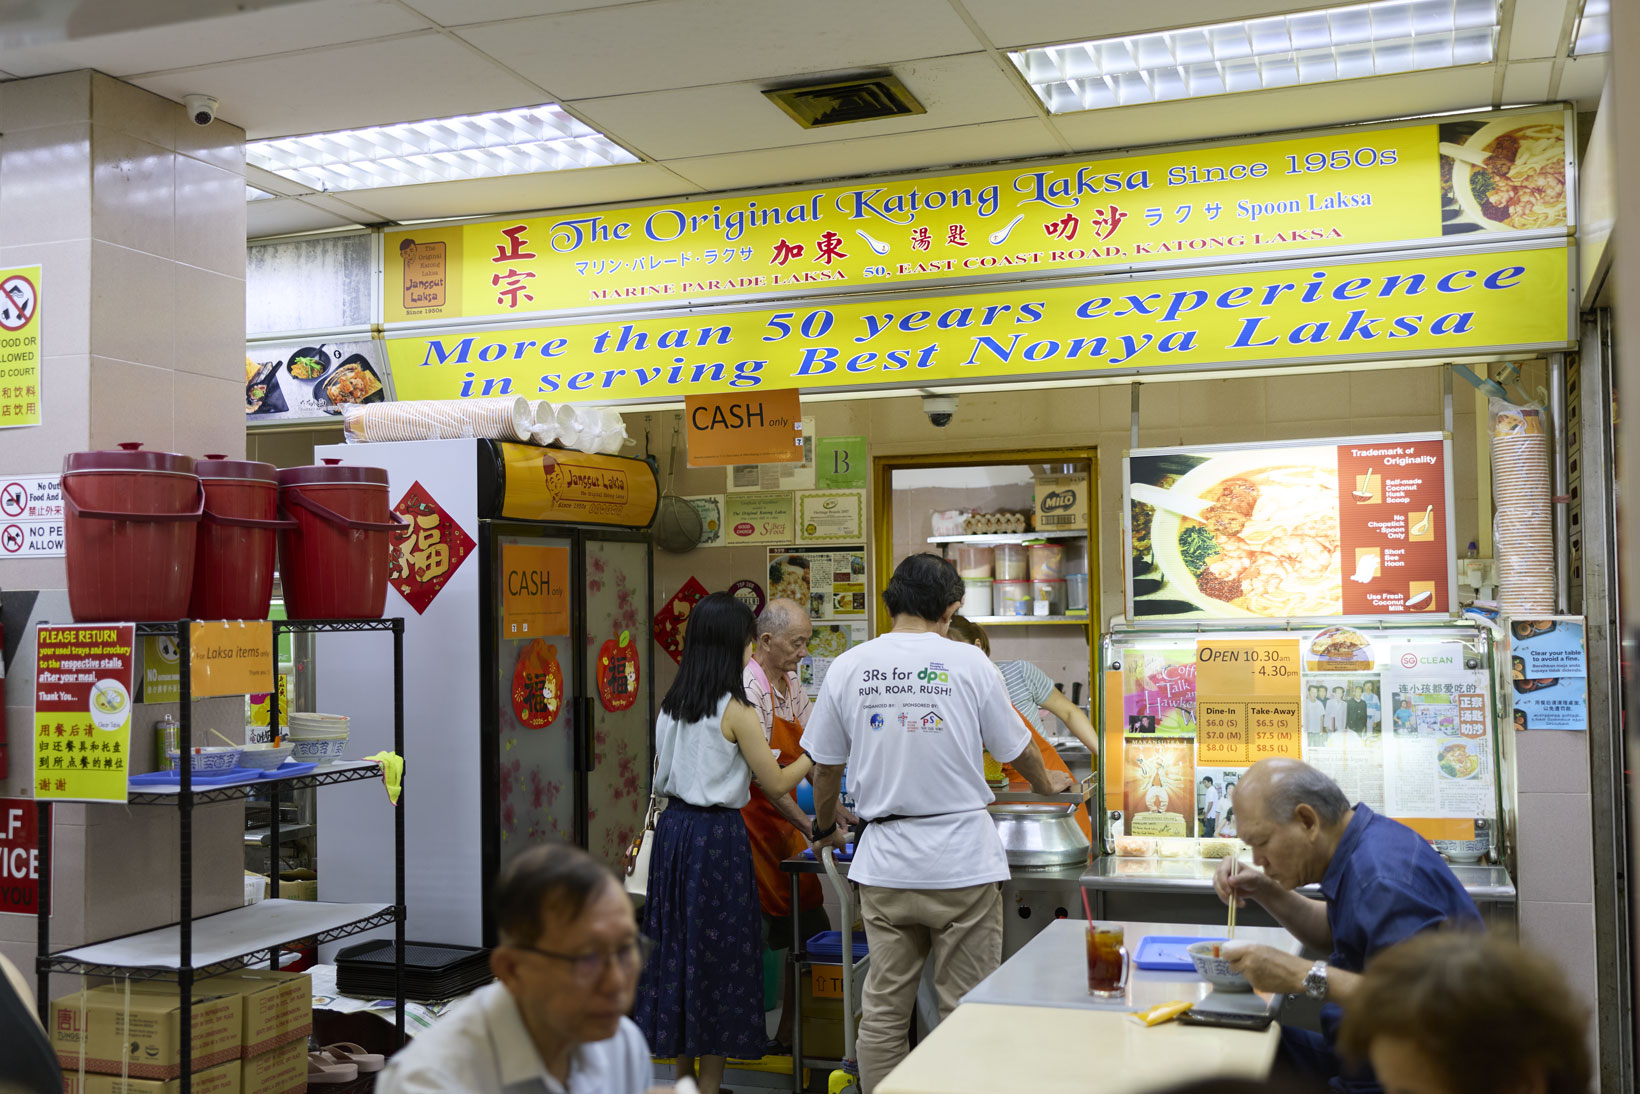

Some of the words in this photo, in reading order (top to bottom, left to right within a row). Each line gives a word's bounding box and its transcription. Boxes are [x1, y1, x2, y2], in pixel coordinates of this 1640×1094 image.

[550, 217, 632, 253] The
[645, 194, 826, 242] Original
[835, 184, 999, 225] Katong
[1013, 166, 1153, 208] Laksa
[1167, 161, 1268, 187] Since
[1285, 146, 1398, 176] 1950s
[1236, 200, 1300, 221] Spoon
[1308, 192, 1373, 212] Laksa
[863, 265, 892, 280] 50,
[897, 259, 957, 275] EAST
[963, 252, 1044, 269] COAST
[1050, 245, 1128, 262] ROAD,
[1133, 235, 1246, 256] KATONG
[1253, 227, 1345, 246] LAKSA
[491, 224, 537, 309] 正宗
[406, 278, 443, 291] Janggut
[590, 283, 675, 301] MARINE
[681, 276, 767, 293] PARADE
[772, 269, 848, 286] LAKSA
[411, 292, 438, 303] Laksa
[418, 336, 568, 367] More
[593, 324, 734, 355] than
[762, 309, 835, 342] 50
[854, 301, 1046, 343] years
[1075, 265, 1526, 324] experience
[24, 337, 36, 346] OR
[459, 372, 514, 398] in
[538, 356, 768, 388] serving
[790, 342, 940, 377] Best
[960, 329, 1199, 365] Nonya
[1225, 308, 1475, 350] Laksa
[8, 367, 35, 377] COURT
[691, 402, 765, 431] CASH
[768, 417, 789, 428] only
[1351, 447, 1403, 457] Trademark
[833, 449, 850, 474] B
[1384, 456, 1437, 466] Originality
[567, 469, 599, 489] Janggut
[1385, 478, 1422, 486] Self-made
[29, 493, 44, 501] Food
[46, 493, 59, 501] And
[1045, 494, 1074, 508] MILO
[30, 527, 45, 537] NO
[508, 570, 550, 596] CASH
[551, 587, 563, 598] only
[40, 631, 76, 643] PLEASE
[79, 630, 117, 642] RETURN
[40, 647, 54, 657] your
[56, 646, 71, 654] used
[72, 646, 90, 656] trays
[91, 645, 102, 654] and
[104, 645, 131, 656] crockery
[207, 647, 233, 660] Laksa
[236, 646, 260, 659] items
[1199, 647, 1240, 662] OPEN
[1549, 650, 1563, 658] your
[40, 660, 47, 668] to
[49, 660, 60, 668] the
[61, 657, 99, 671] respective
[100, 657, 122, 668] stalls
[1420, 656, 1453, 664] CLEAN
[39, 671, 59, 682] after
[61, 673, 77, 684] your
[78, 671, 97, 682] meal.
[147, 669, 157, 681] NO
[607, 656, 629, 695] 福
[863, 669, 887, 682] 3Rs
[892, 667, 912, 681] for
[917, 667, 949, 684] dpa
[1162, 664, 1196, 681] Coff
[859, 686, 881, 696] RUN,
[885, 685, 916, 695] ROAR,
[920, 685, 952, 697] RUSH!
[1156, 679, 1191, 698] Talk
[39, 691, 58, 701] Thank
[1206, 707, 1236, 715] Dine-In
[1251, 707, 1296, 716] Take-Away
[39, 722, 95, 738] 用餐后请
[1206, 719, 1224, 728] $6.0
[1226, 719, 1238, 728] (S)
[1256, 719, 1274, 728] $6.5
[1277, 719, 1289, 728] (S)
[1206, 731, 1224, 740] $7.0
[1226, 731, 1242, 740] (M)
[1256, 731, 1274, 740] $7.5
[1277, 731, 1292, 740] (M)
[1206, 744, 1224, 753] $8.0
[1226, 744, 1238, 753] (L)
[1256, 744, 1274, 753] $8.5
[1277, 744, 1289, 753] (L)
[38, 778, 67, 792] 谢谢
